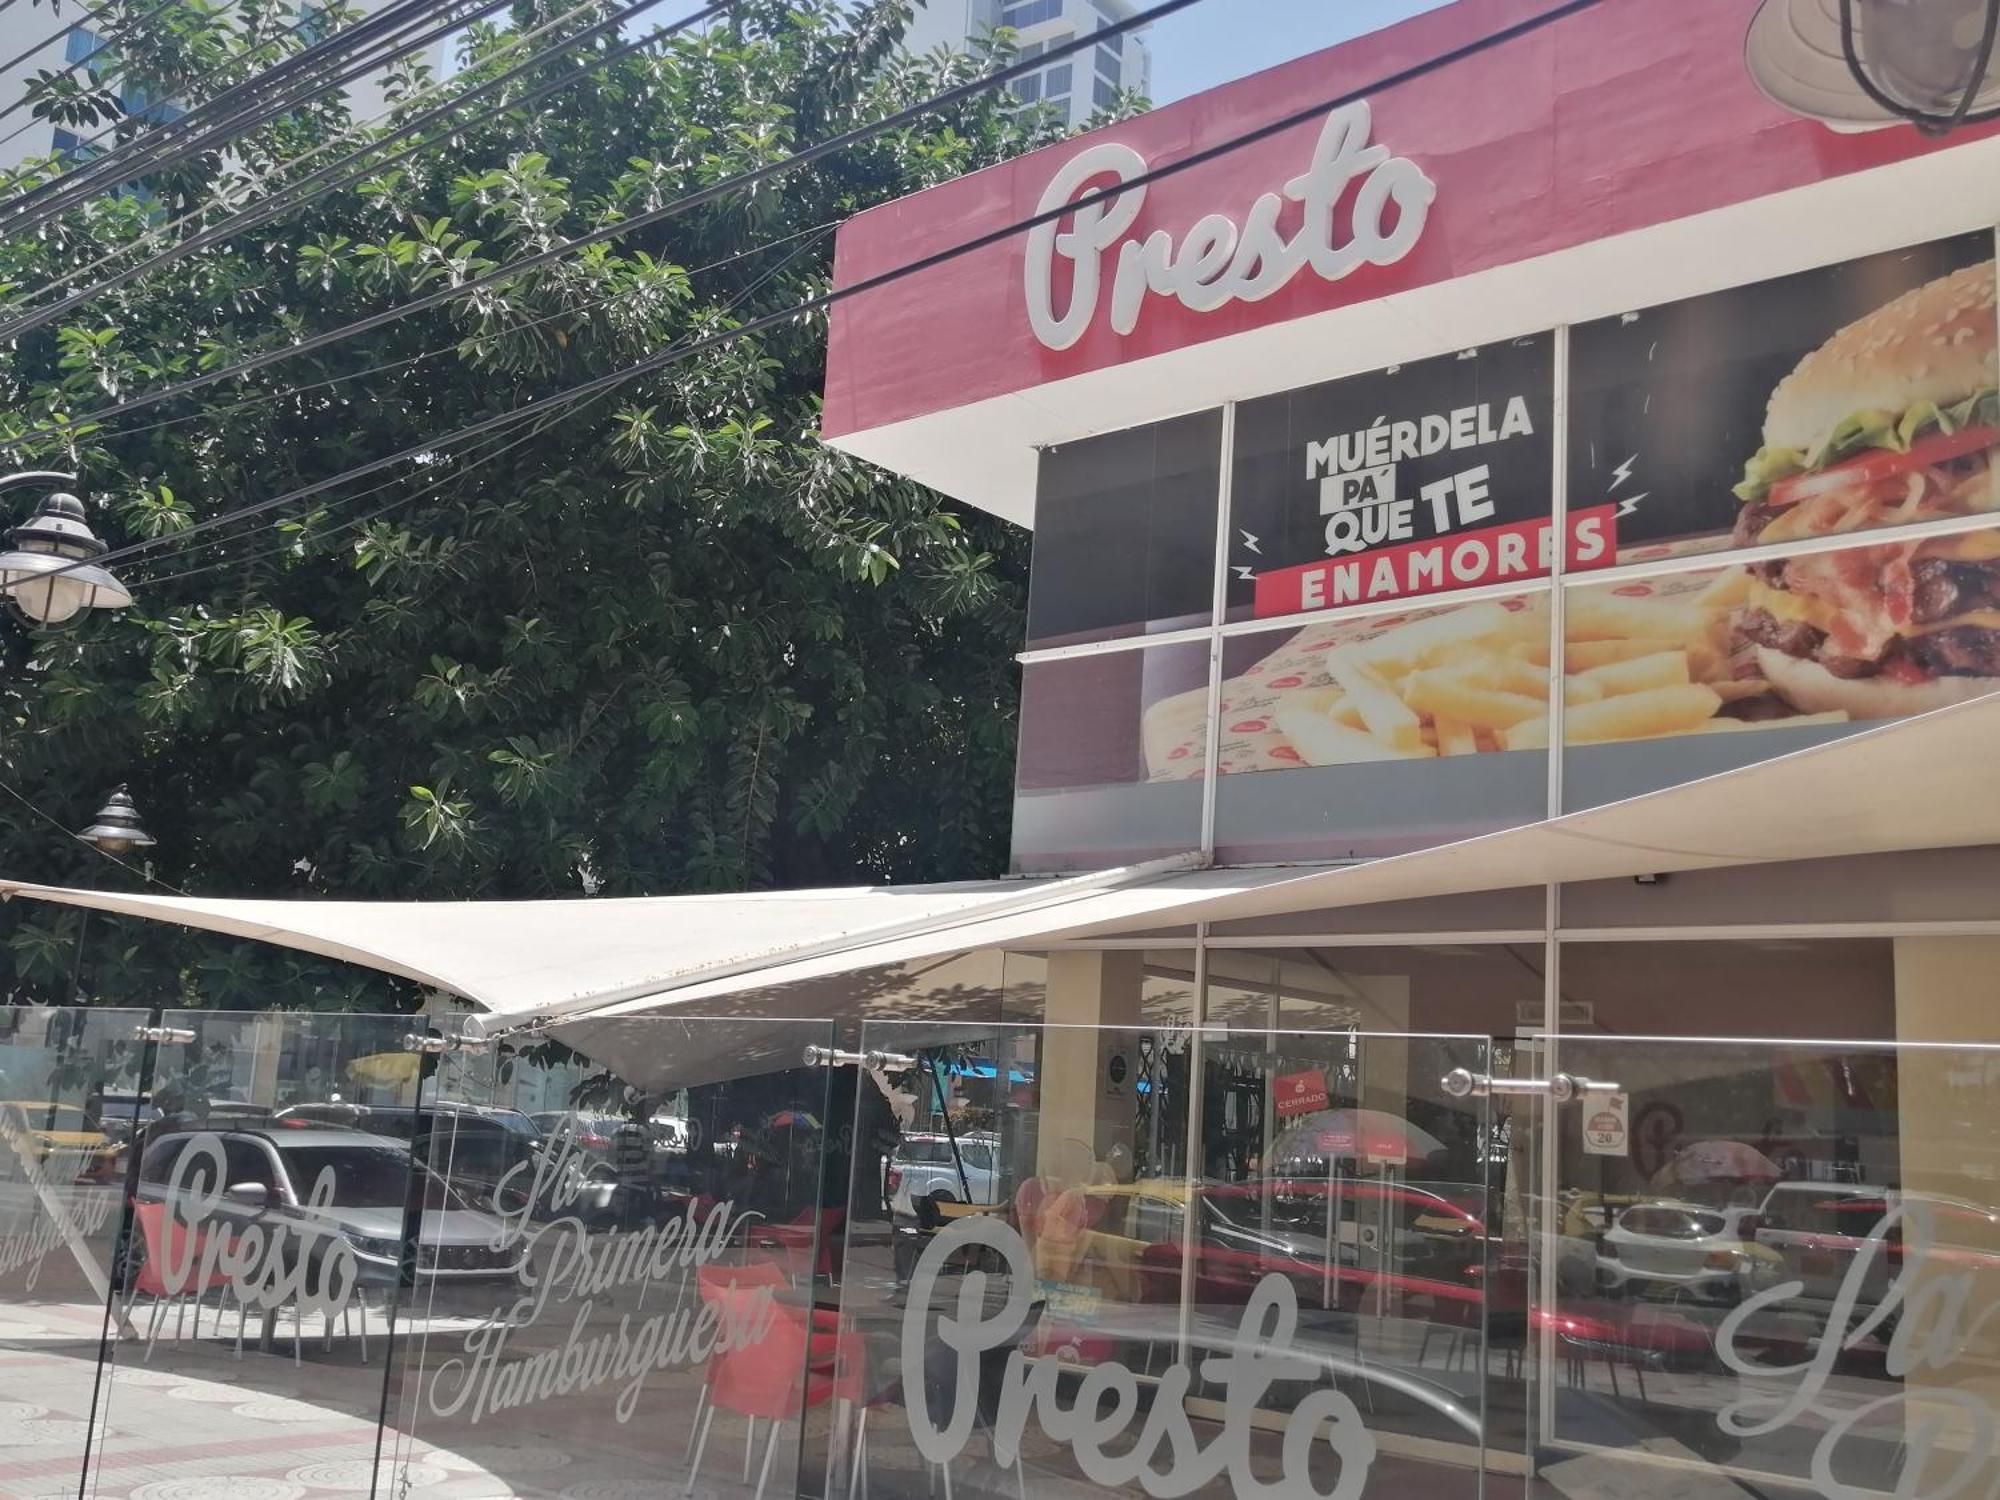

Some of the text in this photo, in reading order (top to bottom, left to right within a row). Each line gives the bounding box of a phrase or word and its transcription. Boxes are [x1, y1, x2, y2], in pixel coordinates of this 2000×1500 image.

[1024, 99, 1437, 351] Presto
[1306, 395, 1534, 481] MUÉRDELA
[1324, 464, 1495, 555] QUE TE
[160, 1135, 358, 1318] Presto
[505, 1197, 767, 1328] Primera
[428, 1277, 777, 1424] Hamburguesa
[902, 1213, 1377, 1500] Presto
